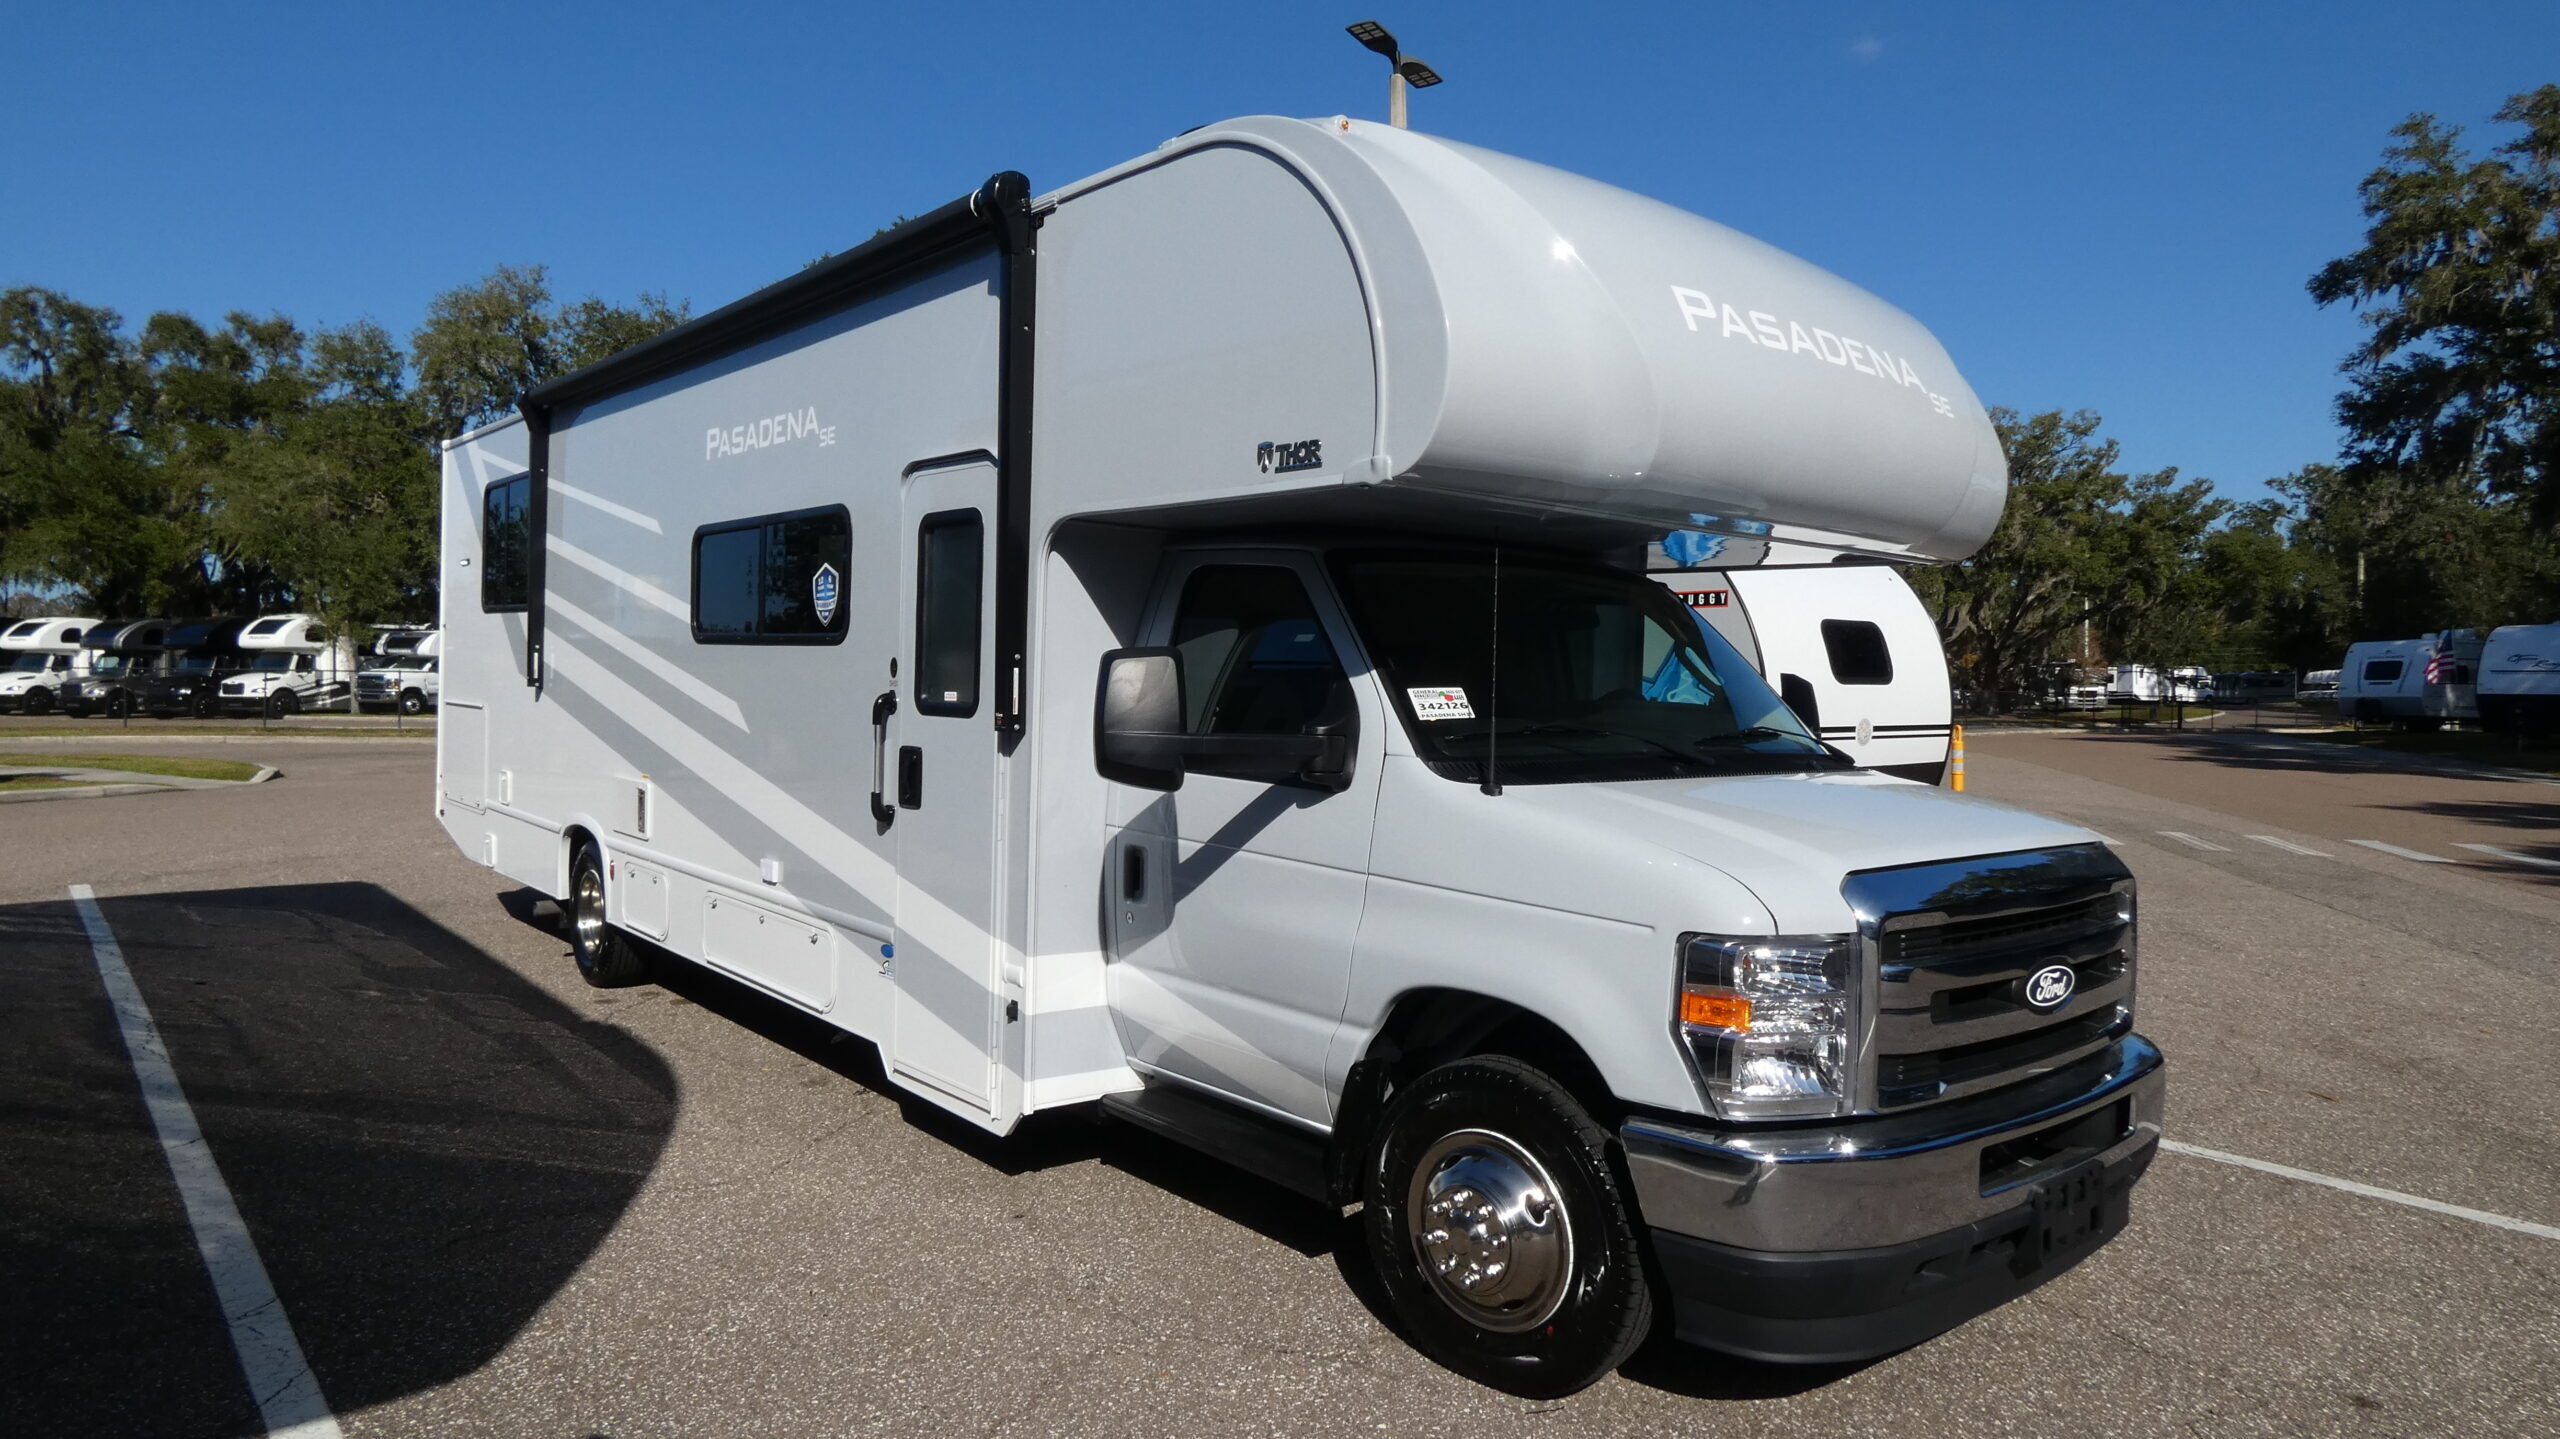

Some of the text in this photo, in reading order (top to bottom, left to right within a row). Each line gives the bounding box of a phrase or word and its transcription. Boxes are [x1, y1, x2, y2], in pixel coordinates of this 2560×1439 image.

[1670, 284, 1955, 419] PASADENA SE
[706, 406, 836, 461] PASADENA SE
[1275, 439, 1321, 467] THOR
[1418, 702, 1469, 711] 342126
[2036, 971, 2067, 1001] Ford
